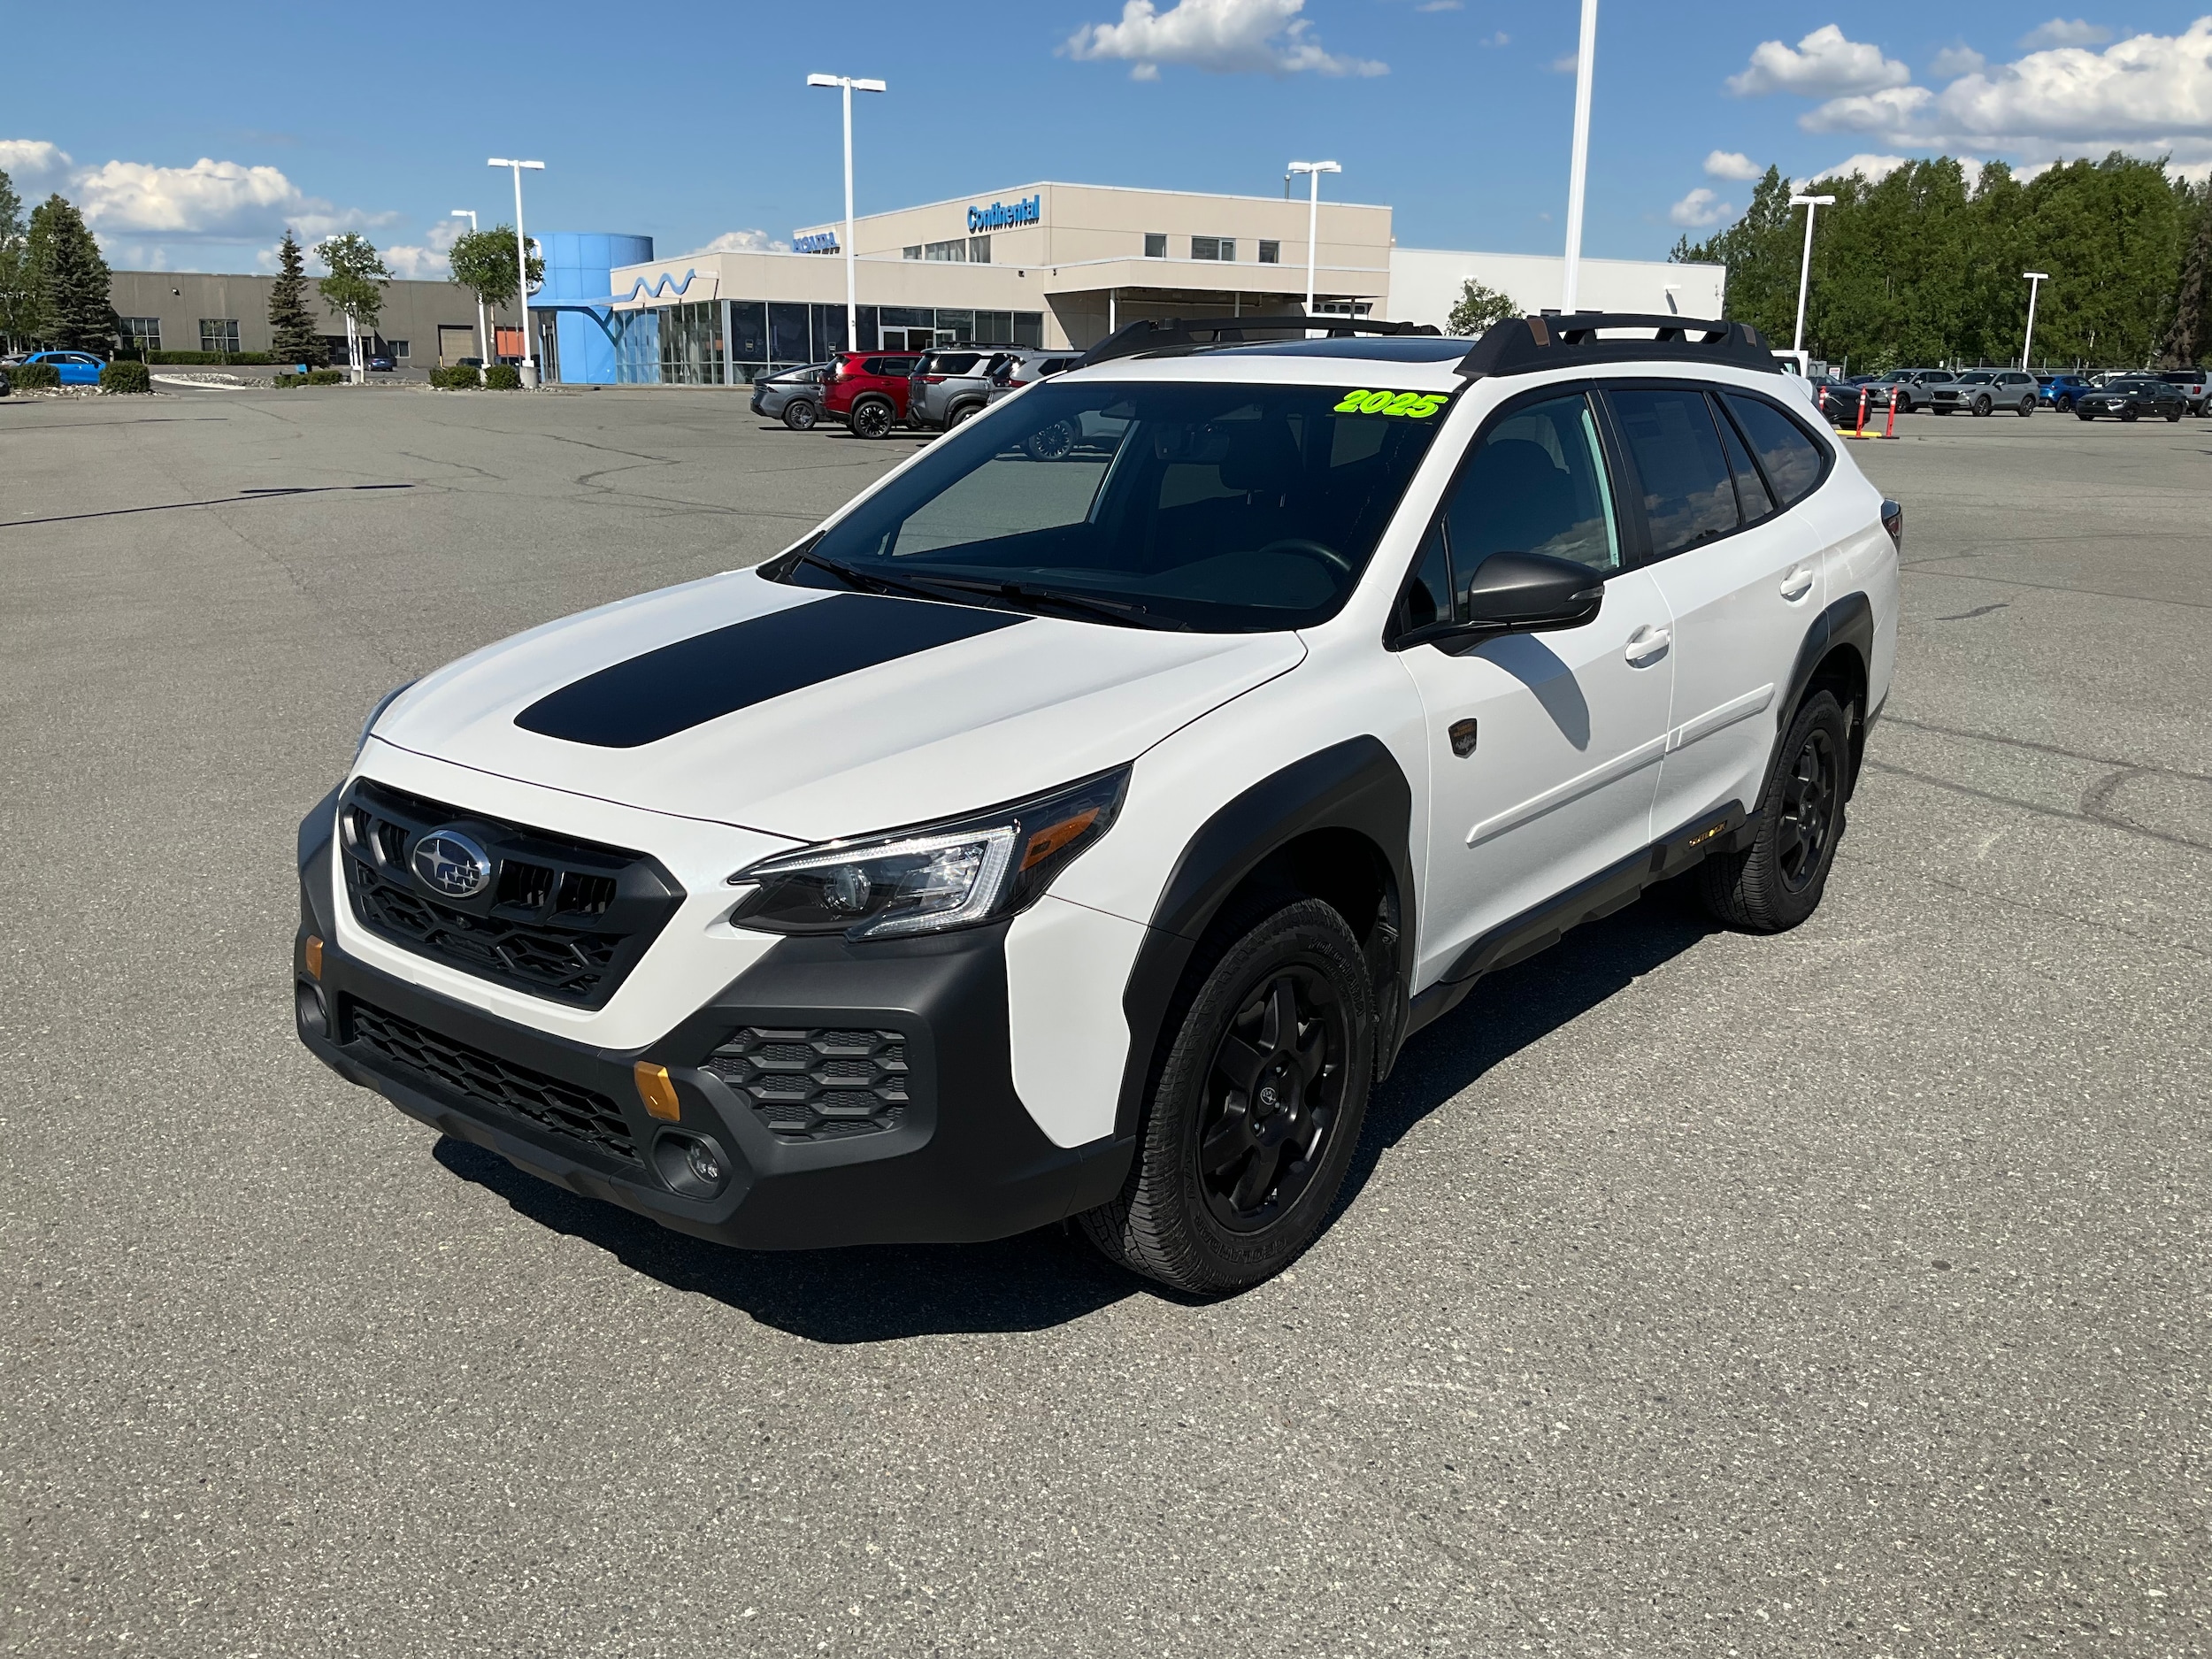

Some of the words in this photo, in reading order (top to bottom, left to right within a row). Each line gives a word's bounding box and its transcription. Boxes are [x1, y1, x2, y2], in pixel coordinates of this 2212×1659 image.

[967, 195, 1040, 229] Continental
[793, 232, 837, 253] HONDA
[1333, 389, 1448, 419] 2025
